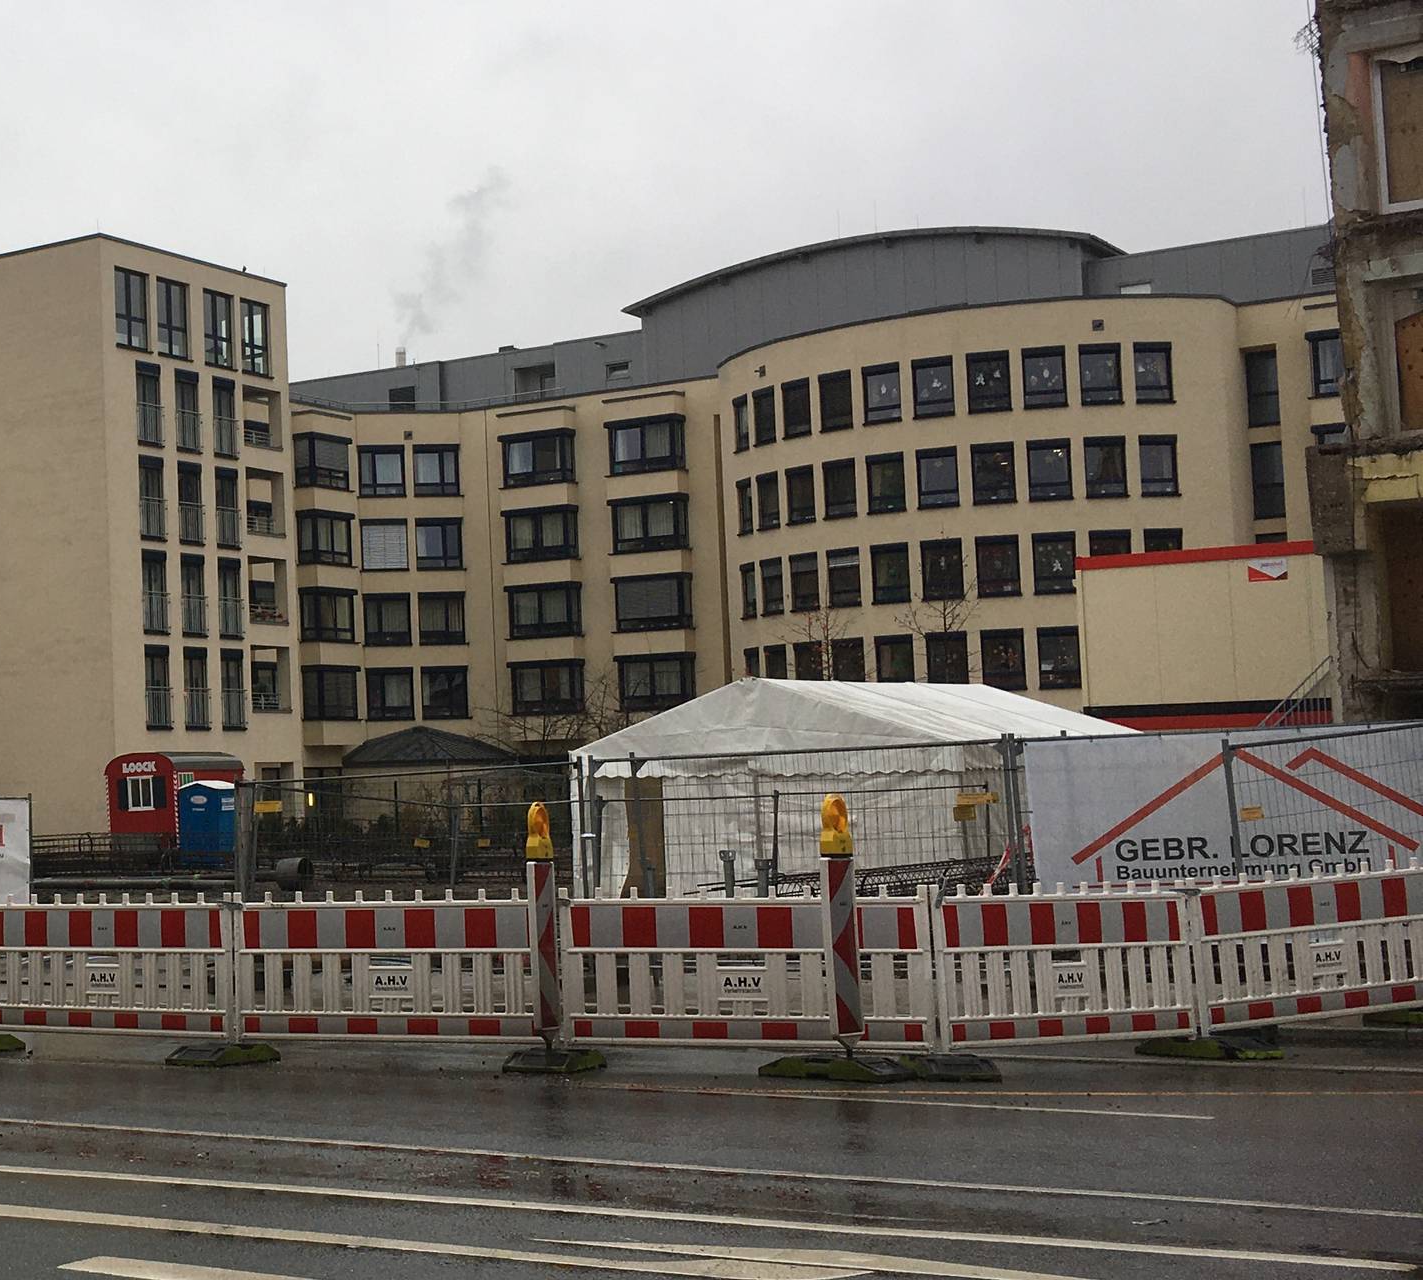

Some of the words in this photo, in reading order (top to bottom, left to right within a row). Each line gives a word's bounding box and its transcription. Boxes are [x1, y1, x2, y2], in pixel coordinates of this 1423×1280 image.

[122, 760, 157, 774] LOOCK
[1115, 836, 1218, 862] GEBR.
[1230, 830, 1369, 858] LORENZ
[1315, 950, 1341, 962] A.H.V
[90, 973, 116, 982] A.H.V
[375, 976, 408, 985] A.H.V
[723, 977, 761, 987] A.H.V
[1057, 972, 1083, 983] A.H.V
